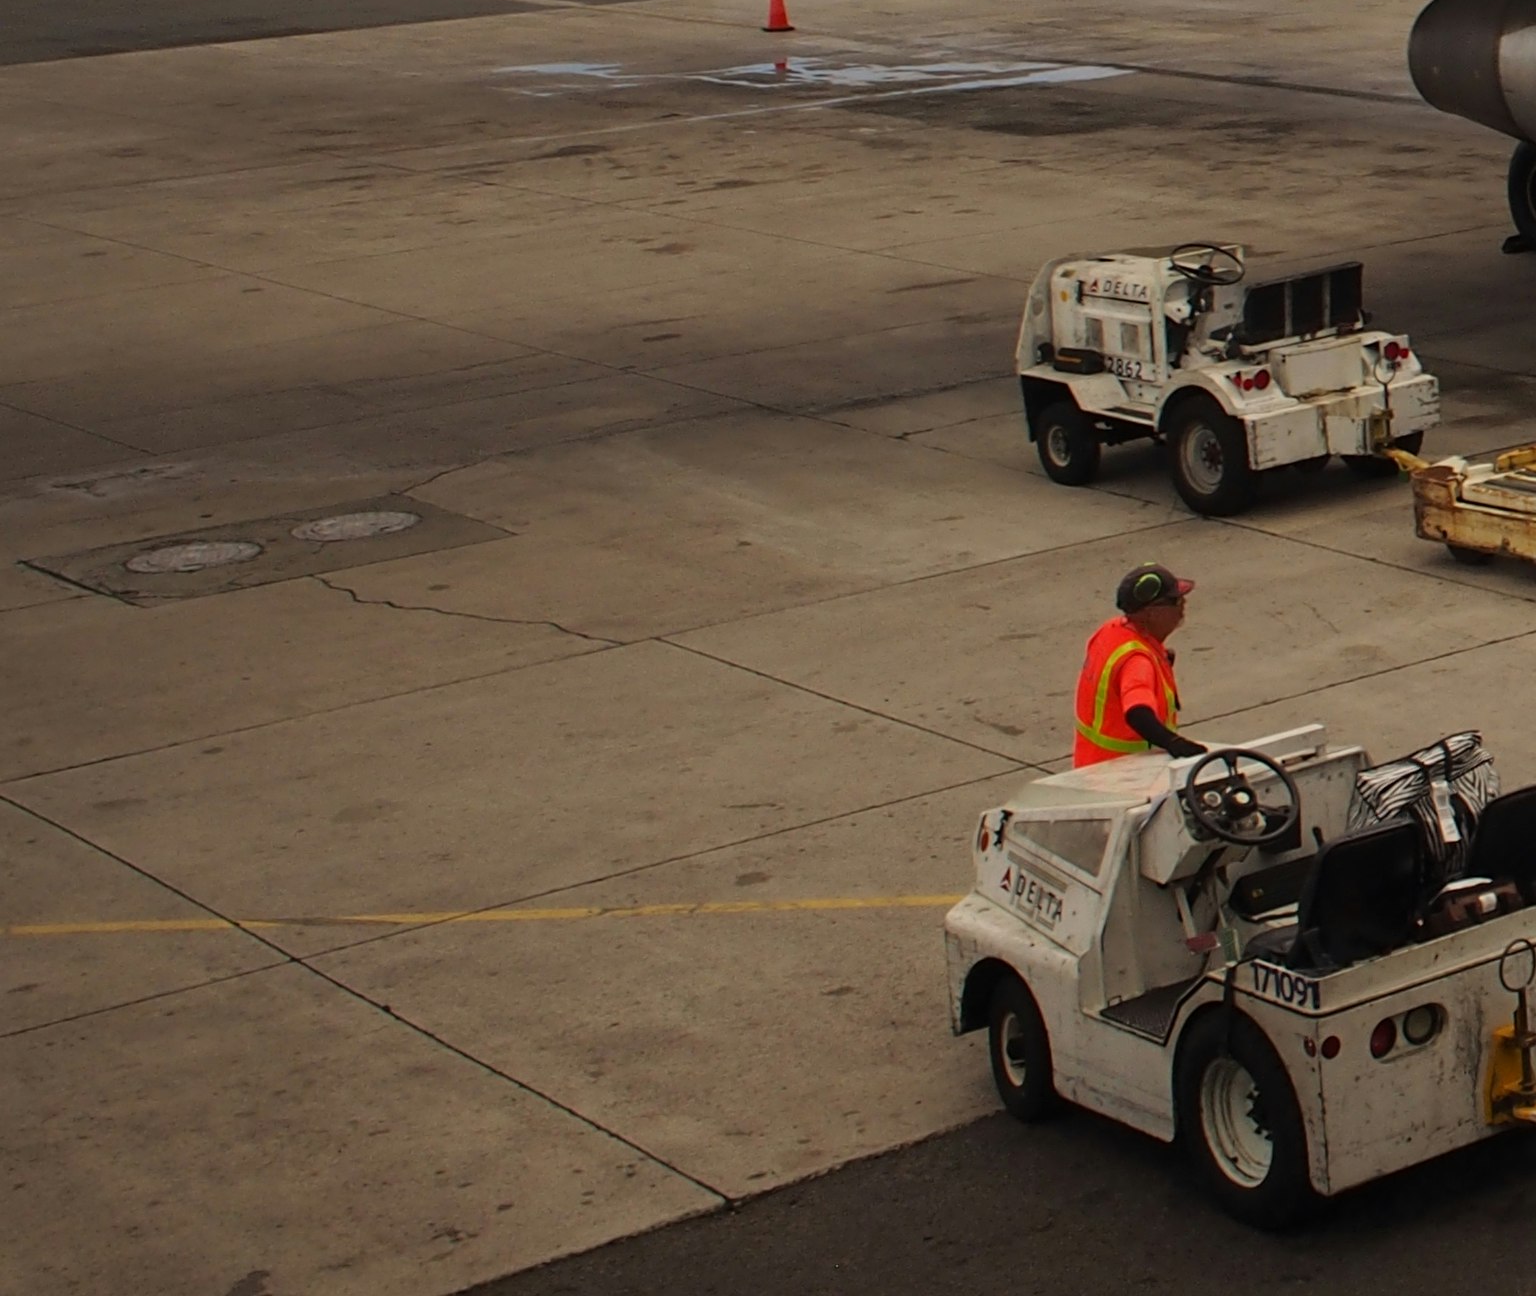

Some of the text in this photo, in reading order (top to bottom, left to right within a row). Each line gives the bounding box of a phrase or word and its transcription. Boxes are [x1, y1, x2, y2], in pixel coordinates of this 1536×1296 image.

[1103, 280, 1148, 298] DELTA
[1016, 873, 1063, 923] DELTA
[1251, 962, 1321, 1010] 171091
